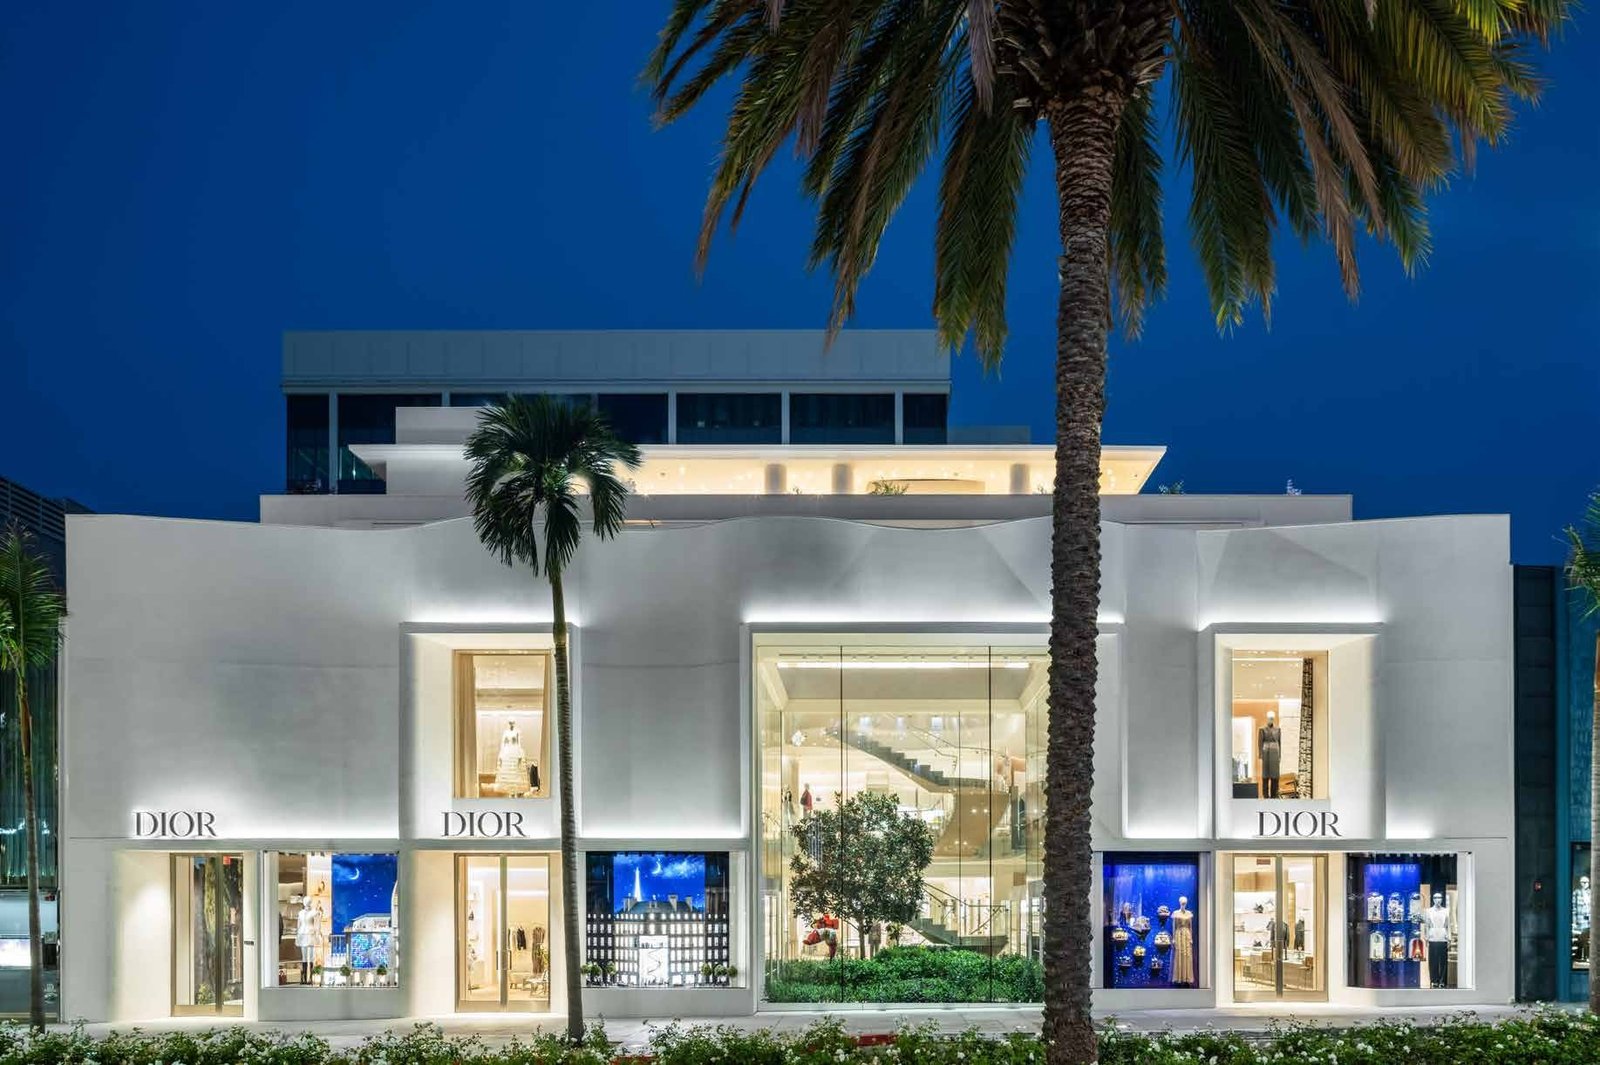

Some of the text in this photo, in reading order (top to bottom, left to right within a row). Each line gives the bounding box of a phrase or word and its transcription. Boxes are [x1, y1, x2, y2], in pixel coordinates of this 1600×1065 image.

[134, 811, 216, 837] DIOR
[441, 811, 526, 837] DIOR
[1256, 811, 1342, 837] DIOR
